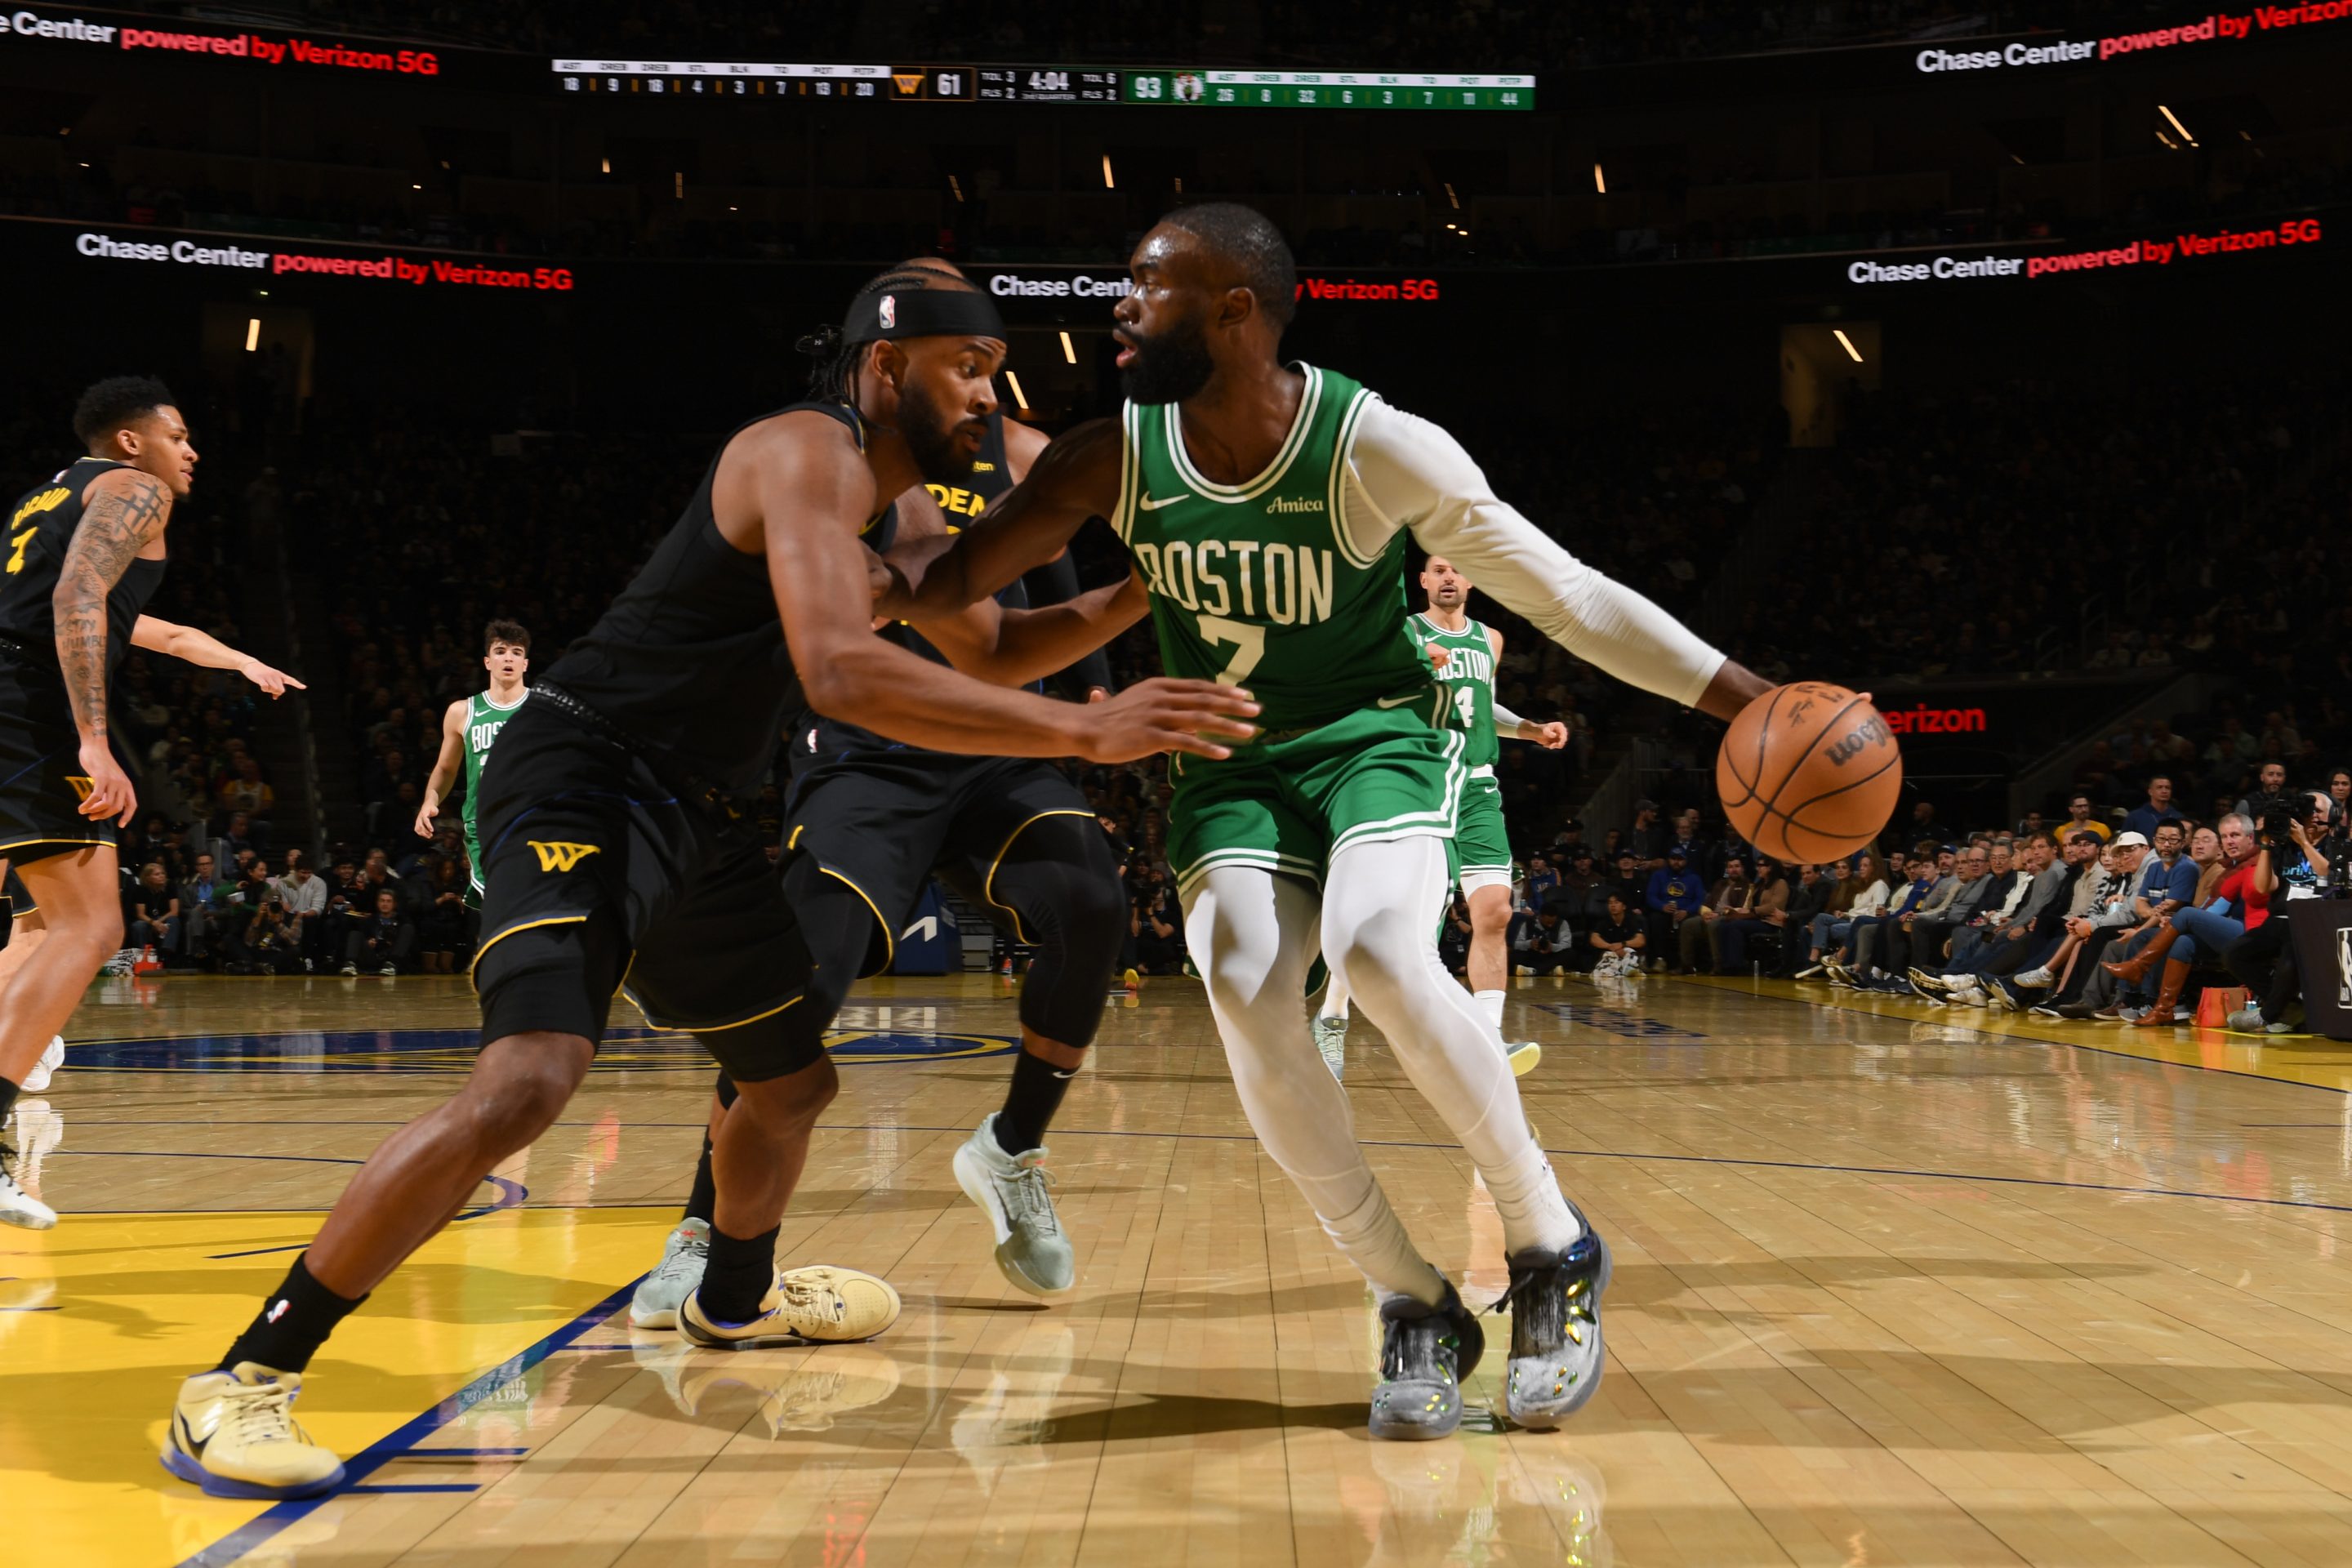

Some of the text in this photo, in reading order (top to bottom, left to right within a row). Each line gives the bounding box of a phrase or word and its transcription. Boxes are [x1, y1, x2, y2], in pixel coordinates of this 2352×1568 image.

[12, 11, 118, 42] Center
[121, 27, 247, 56] powered
[252, 35, 286, 65] by
[288, 38, 394, 70] Verizon
[397, 51, 439, 74] 5G
[1917, 49, 2002, 73] Chase
[2003, 38, 2097, 67] Center
[2099, 16, 2215, 60] powered
[2217, 14, 2252, 38] by
[692, 79, 703, 93] 4
[734, 80, 745, 94] 3
[776, 81, 786, 95] 7
[938, 73, 960, 96] 61
[1005, 71, 1016, 82] 3
[1028, 72, 1070, 91] 4:04
[1106, 73, 1116, 84] 6
[1005, 87, 1016, 99] 2
[1106, 89, 1116, 100] 2
[1134, 77, 1161, 98] 93
[1298, 90, 1316, 103] 32
[1342, 91, 1353, 104] 6
[1383, 91, 1393, 105] 3
[1423, 91, 1434, 105] 7
[1500, 92, 1518, 105] 44
[77, 233, 573, 290] Chase Center powered by Verizon 5G
[1848, 219, 2321, 283] Chase Center powered by Verizon 5G
[990, 275, 1134, 297] Chase Cent
[1306, 279, 1398, 300] Verizon
[1401, 280, 1439, 301] 5G
[1267, 496, 1324, 514] Amica
[1134, 540, 1333, 626] BOSTON
[1196, 613, 1265, 701] 7
